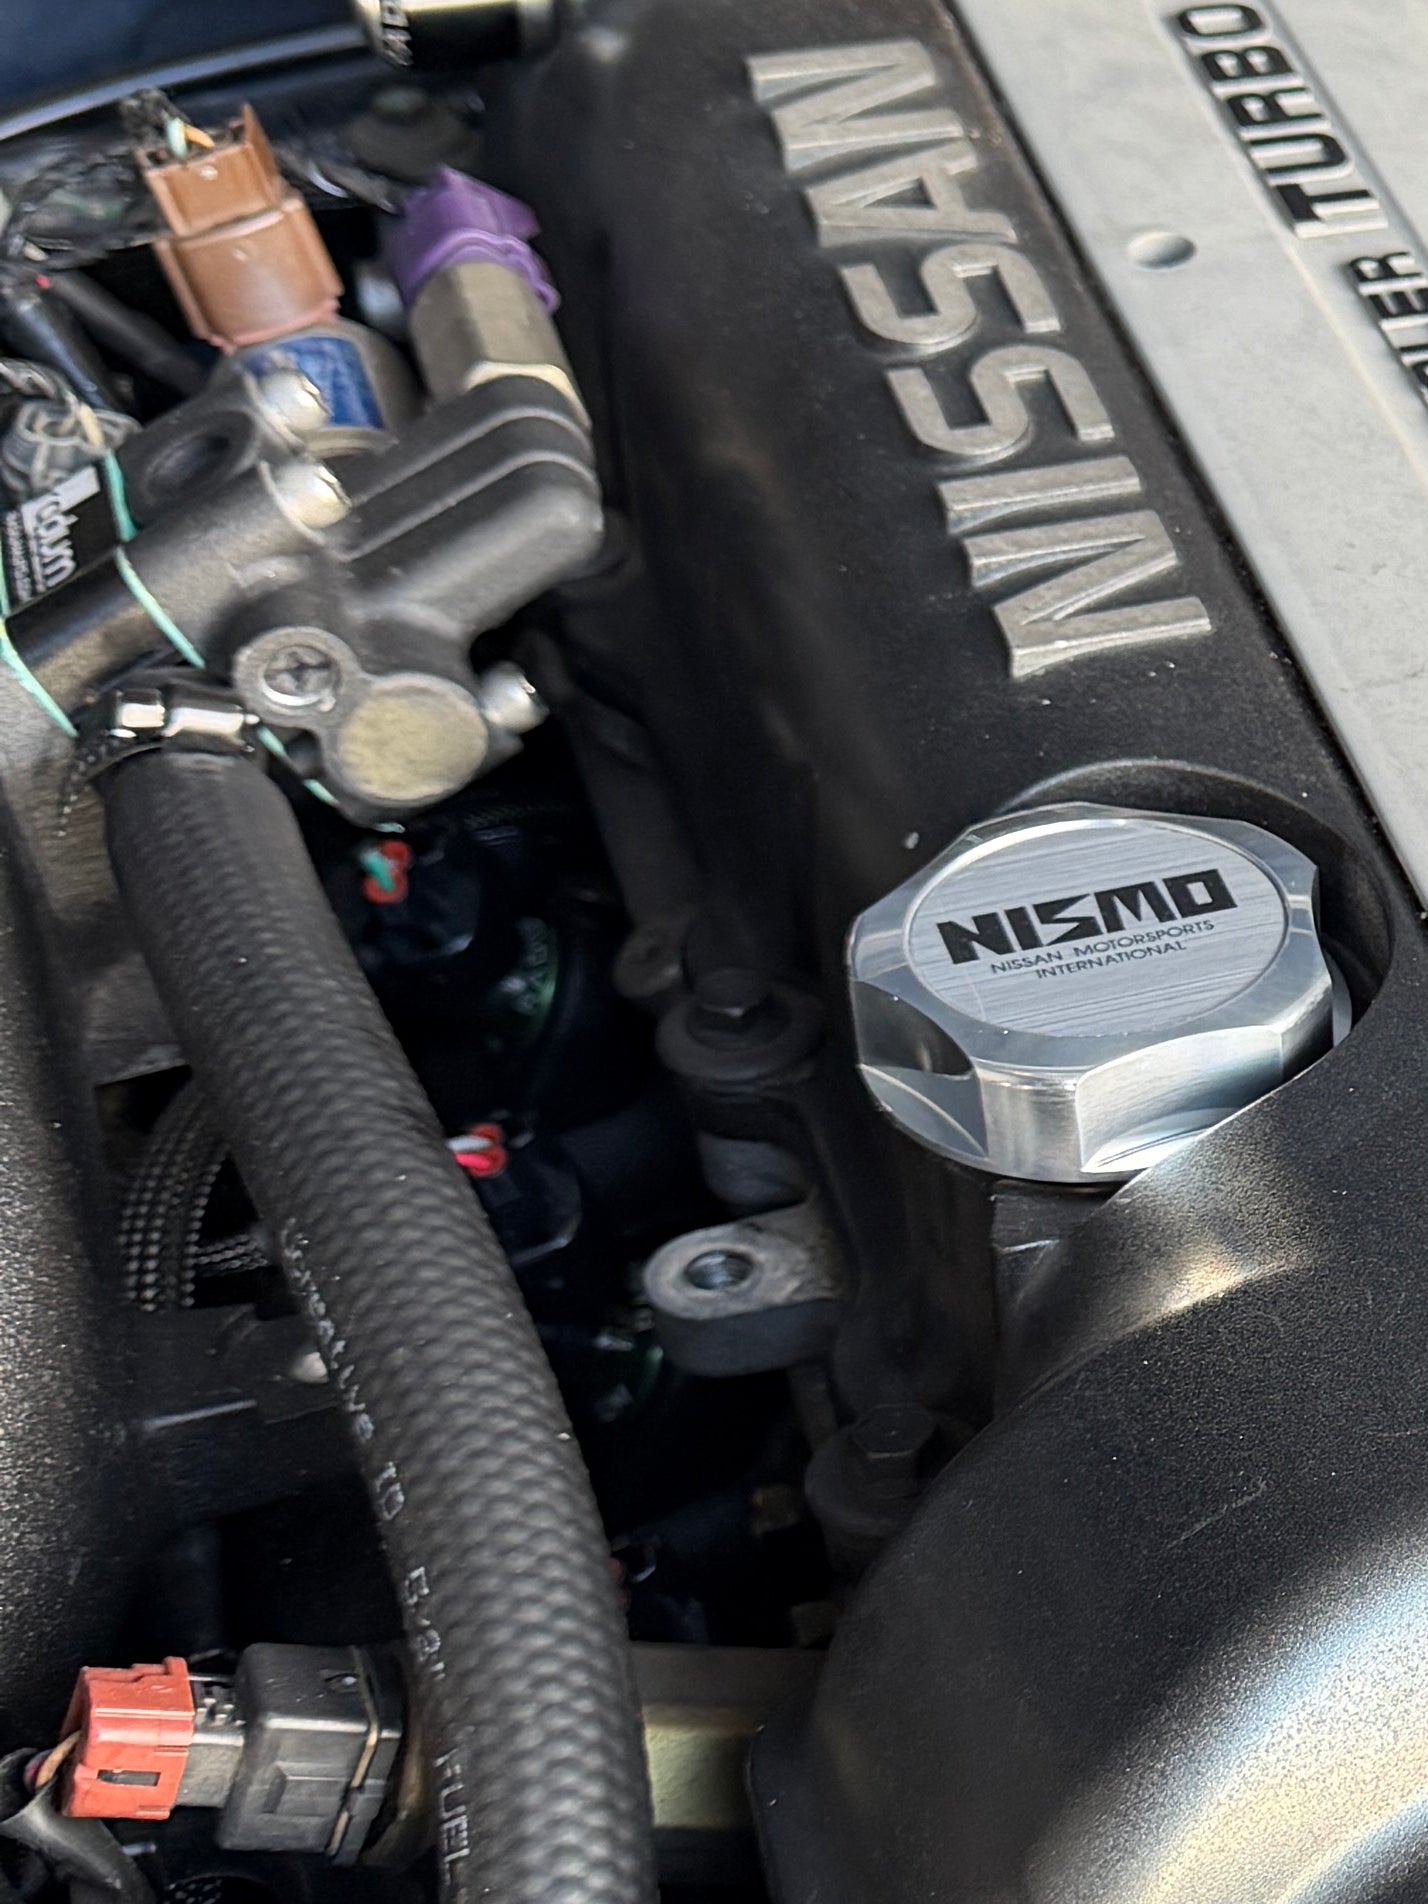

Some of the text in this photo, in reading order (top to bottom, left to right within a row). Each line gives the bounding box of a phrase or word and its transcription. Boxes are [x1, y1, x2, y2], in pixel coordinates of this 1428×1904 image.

[1179, 0, 1388, 240] TURBO
[747, 39, 1211, 678] NISSAN
[936, 868, 1238, 965] NISMO
[990, 919, 1215, 974] NISSAN MOTORSPORTS
[1035, 940, 1187, 979] INTERNATIONAL
[436, 1746, 471, 1876] FUEL
